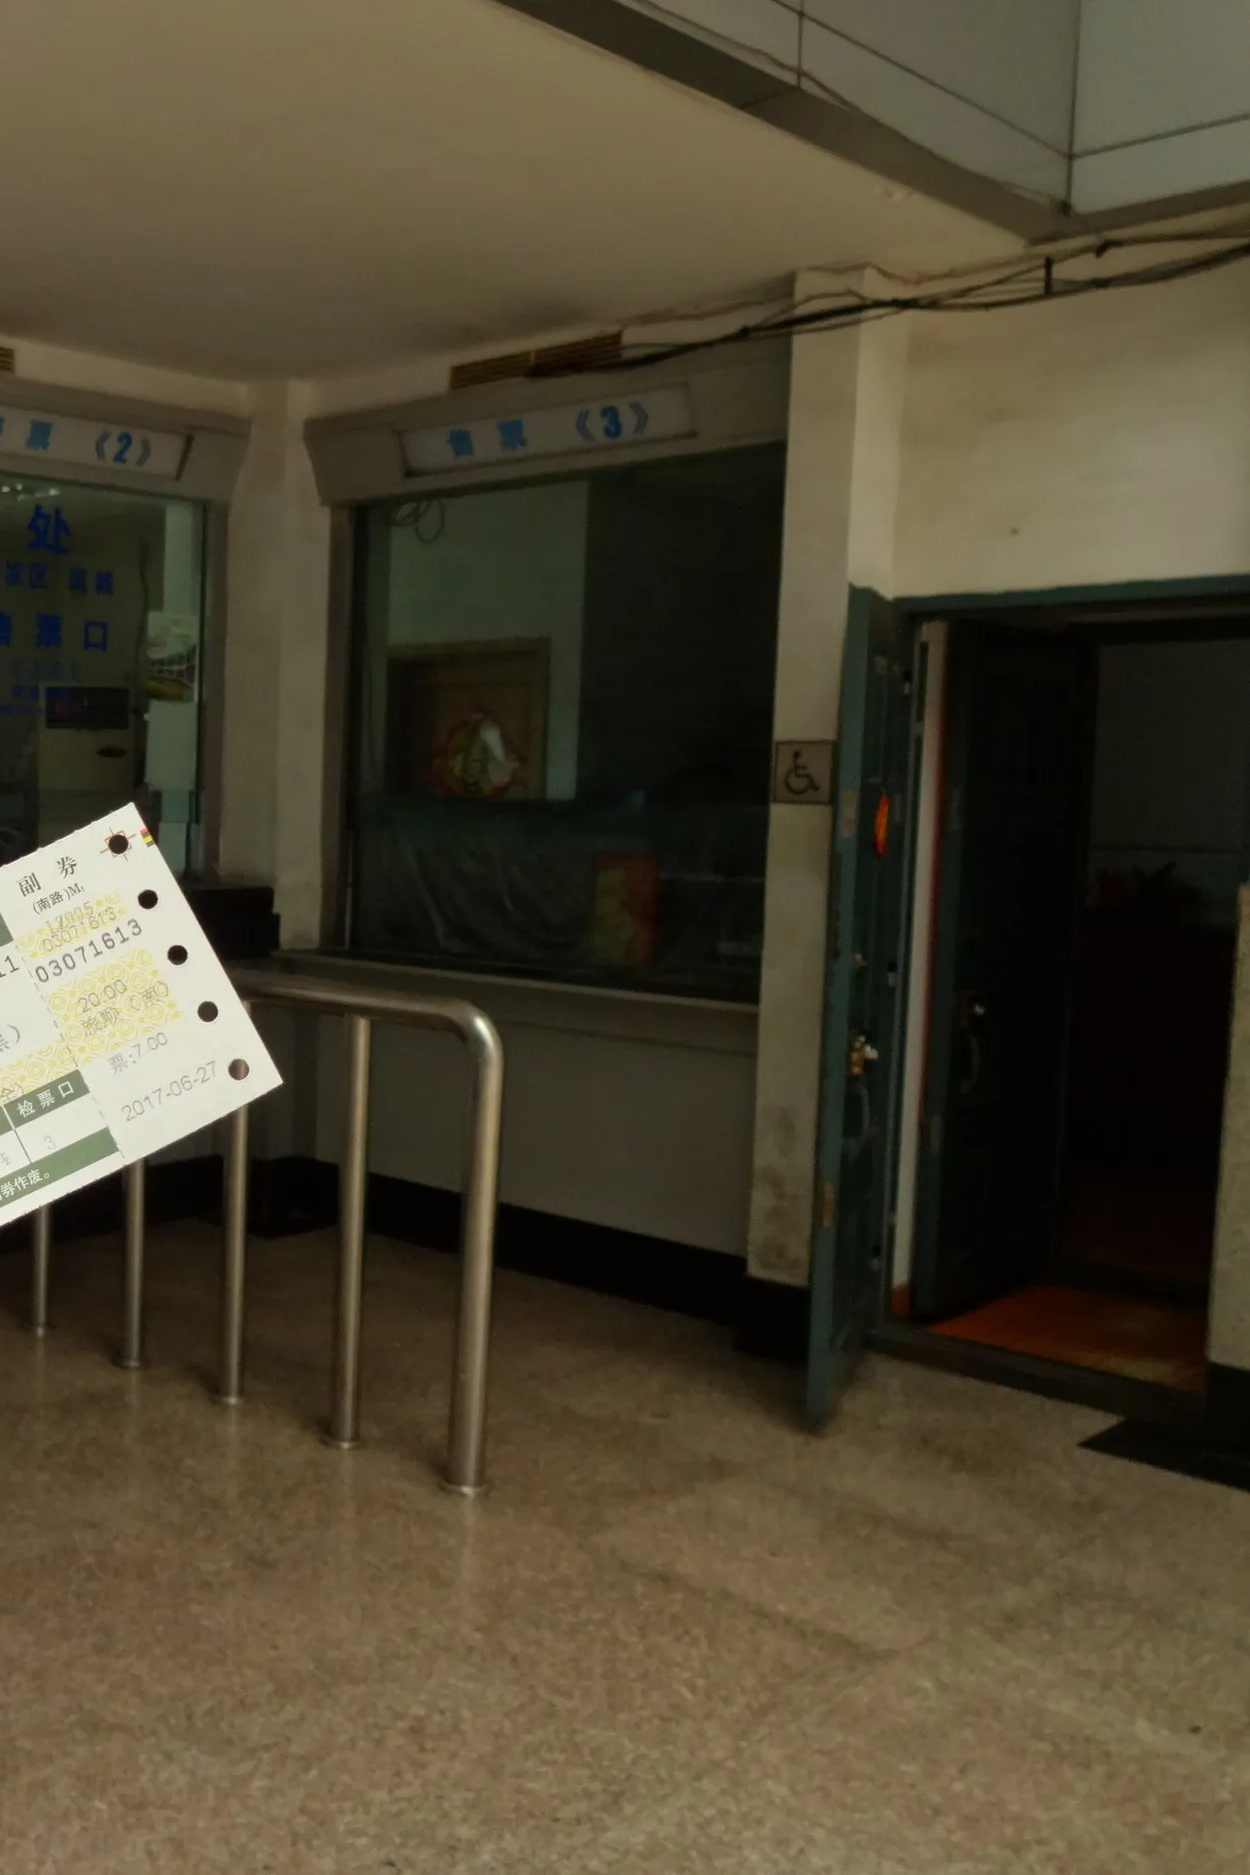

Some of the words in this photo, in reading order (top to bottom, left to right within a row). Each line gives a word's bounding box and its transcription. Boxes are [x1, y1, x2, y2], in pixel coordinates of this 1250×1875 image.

[16, 854, 80, 896] 副券
[34, 918, 140, 982] 03071613
[17, 1082, 74, 1117] 检票口
[120, 1062, 222, 1120] 2017-06-27
[42, 1134, 56, 1150] 3
